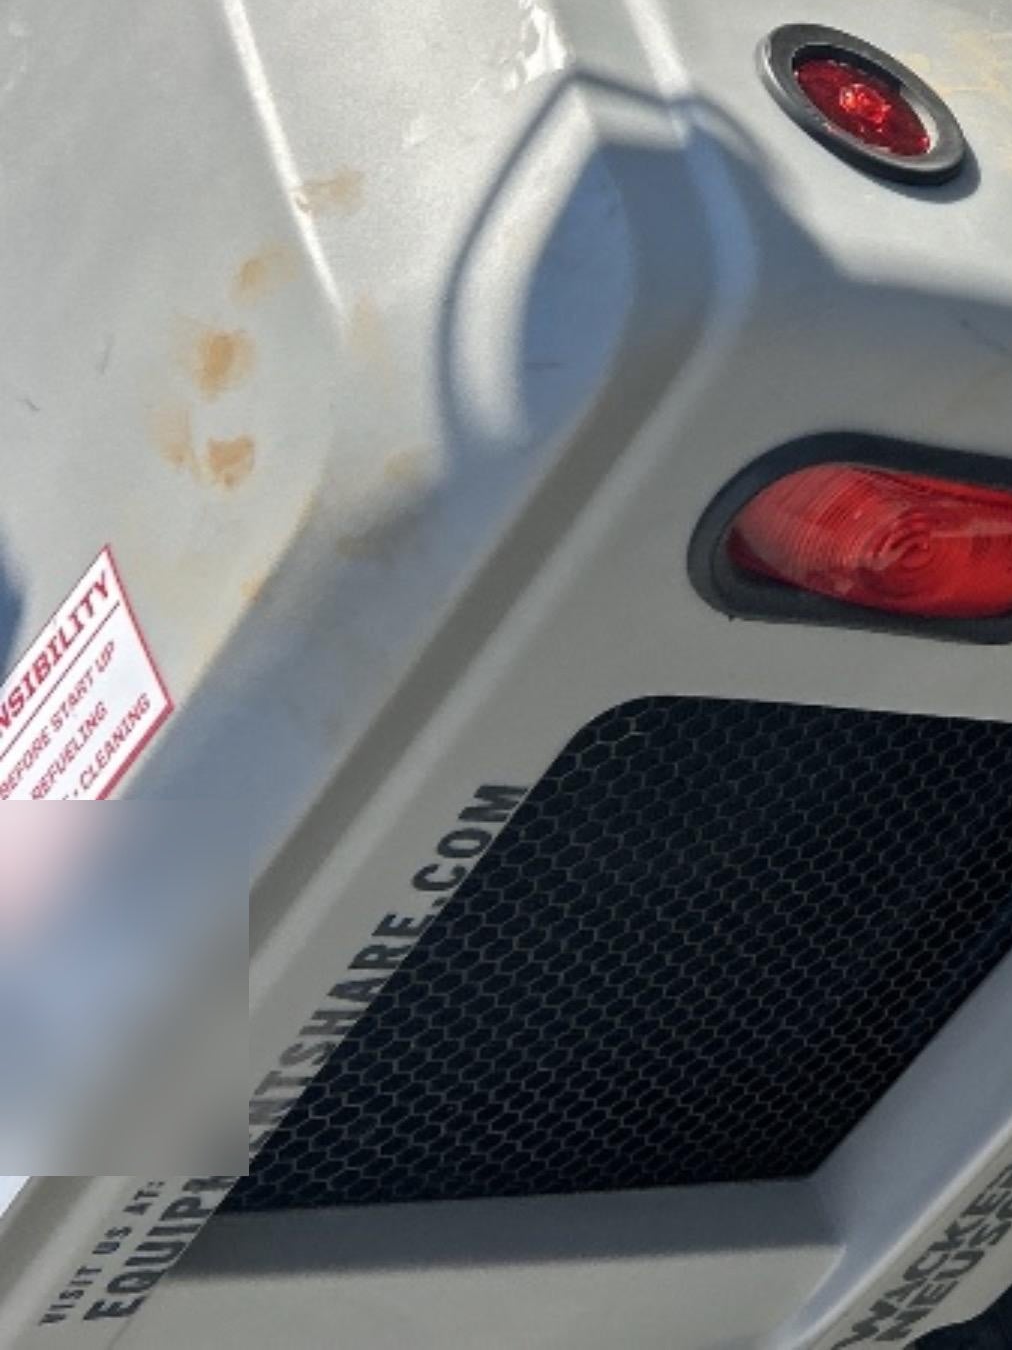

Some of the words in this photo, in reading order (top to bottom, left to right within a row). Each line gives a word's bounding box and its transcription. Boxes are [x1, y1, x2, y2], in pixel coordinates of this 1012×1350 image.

[30, 701, 109, 800] REFUELING
[38, 1266, 102, 1326] VISIT
[92, 1226, 132, 1255] US
